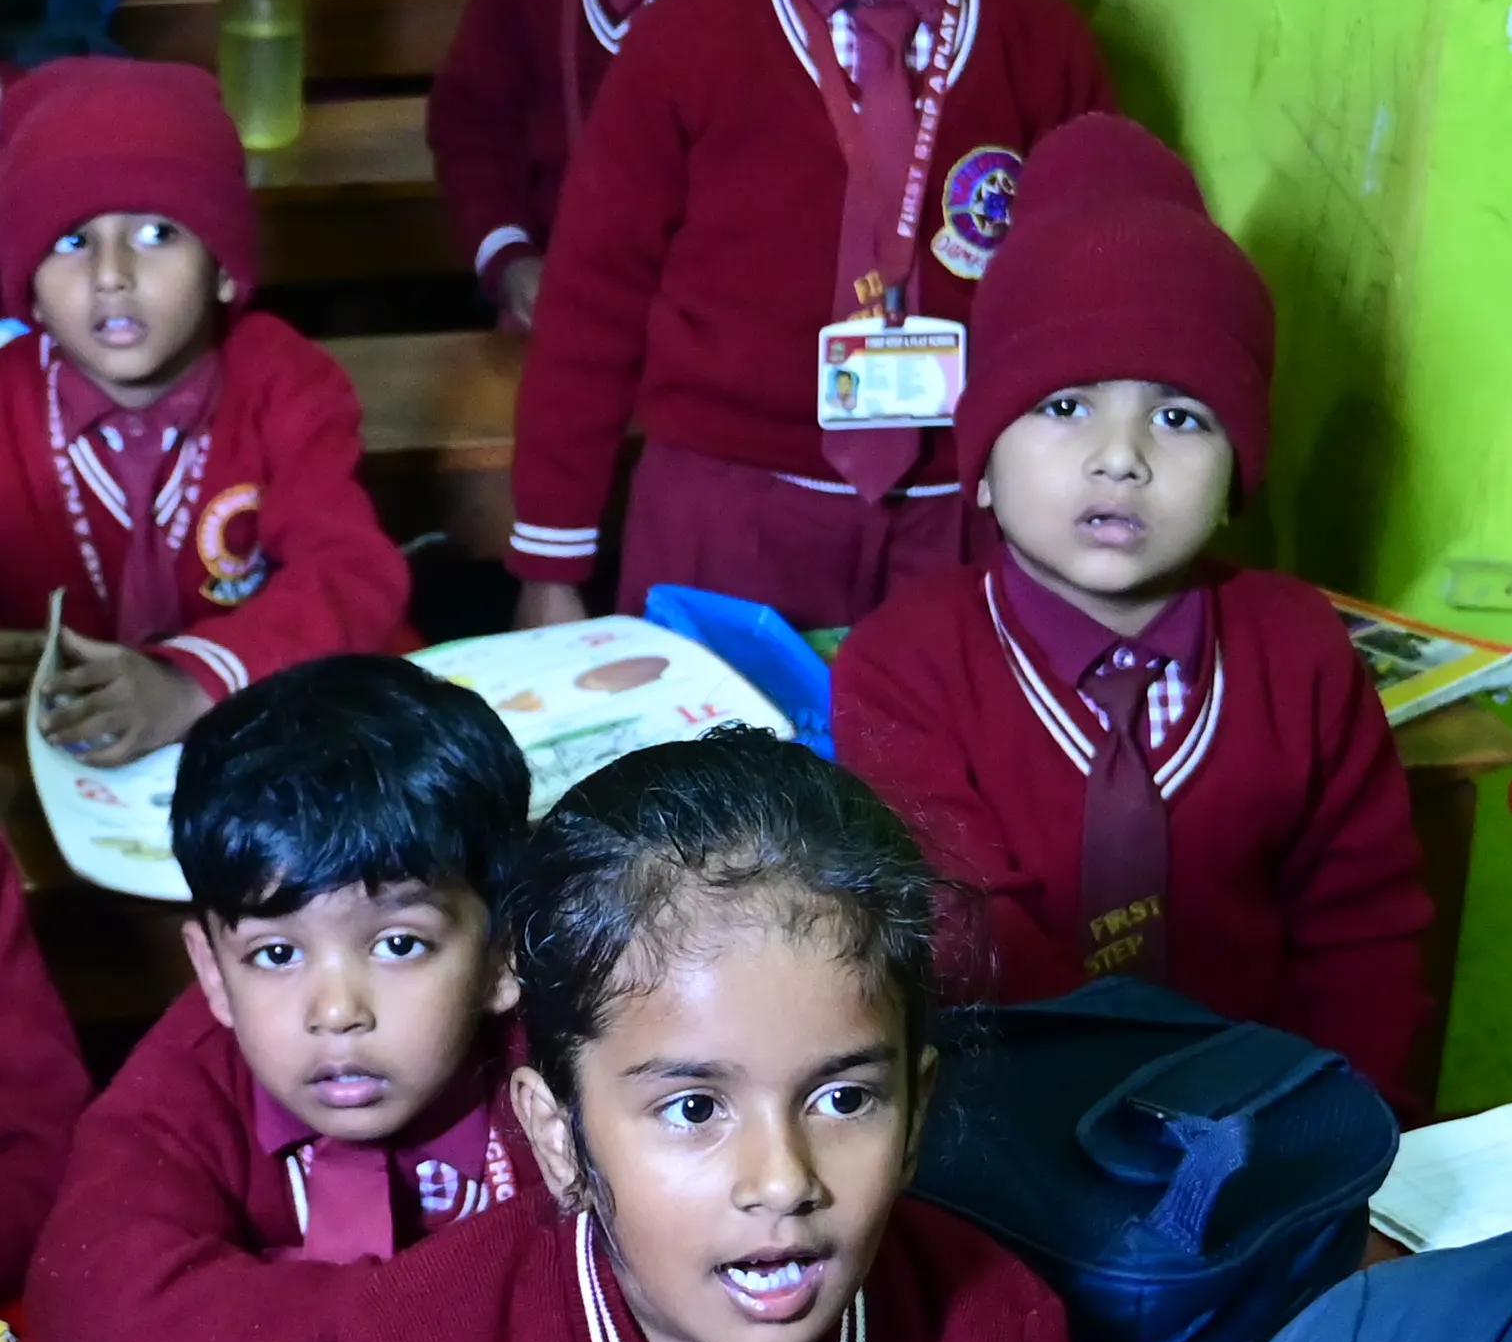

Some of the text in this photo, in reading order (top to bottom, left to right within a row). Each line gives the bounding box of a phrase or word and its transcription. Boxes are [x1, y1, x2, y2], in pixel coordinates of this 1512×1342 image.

[933, 11, 956, 70] PLAY
[929, 75, 945, 94] A
[1090, 894, 1159, 941] FIRST
